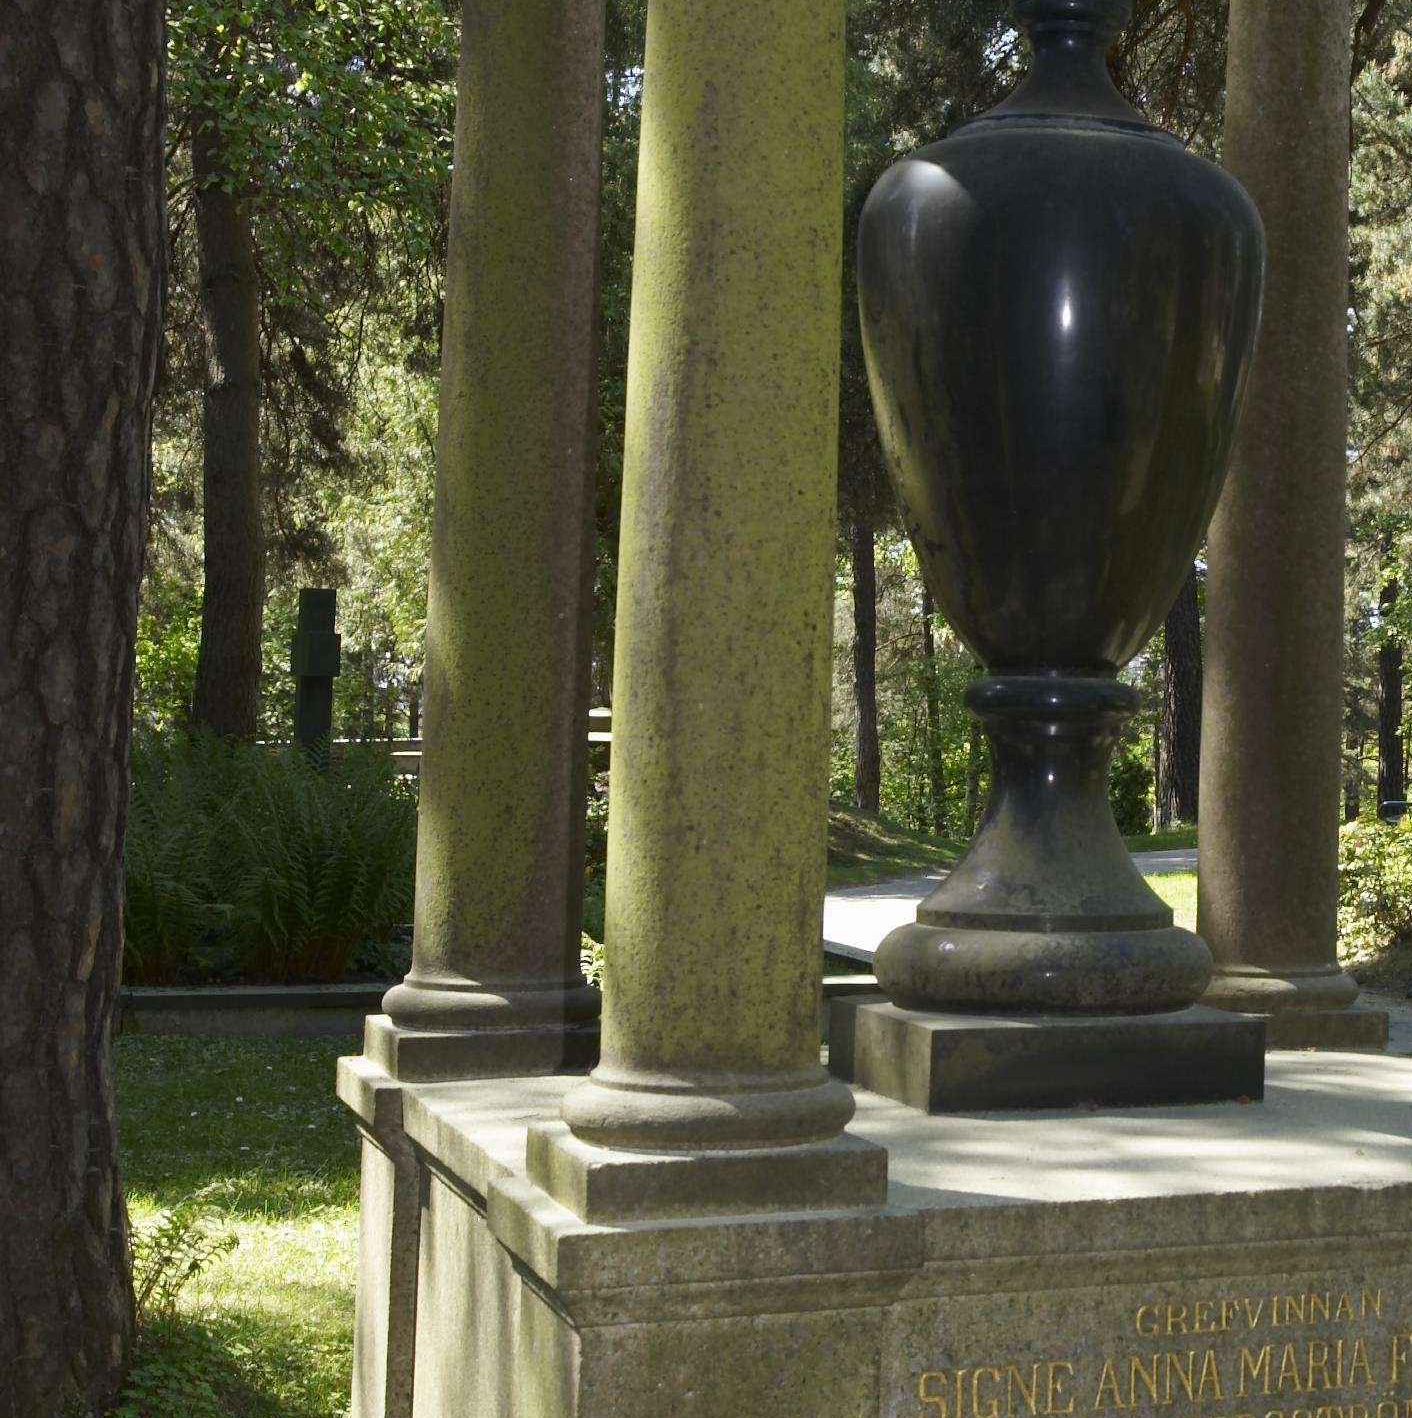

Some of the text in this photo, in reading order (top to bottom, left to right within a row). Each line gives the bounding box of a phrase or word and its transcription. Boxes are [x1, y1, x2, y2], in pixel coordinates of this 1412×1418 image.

[1134, 1287, 1383, 1337] GREFVINNAN
[1092, 1348, 1226, 1411] ANNA
[1236, 1336, 1377, 1398] MARIA
